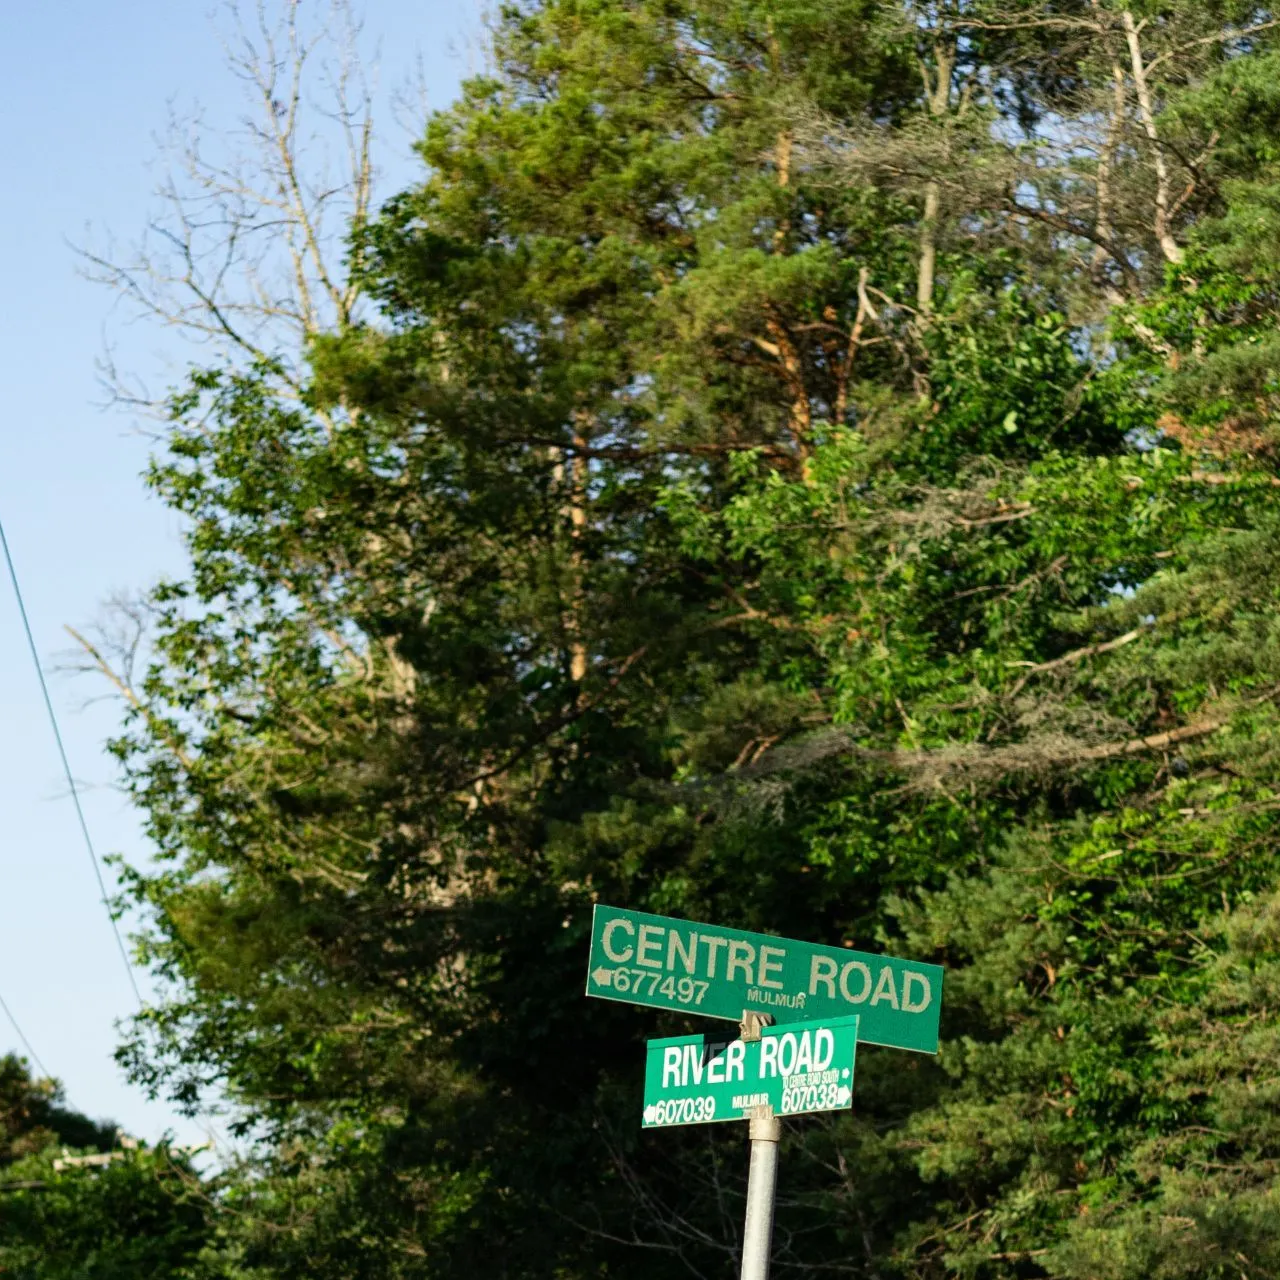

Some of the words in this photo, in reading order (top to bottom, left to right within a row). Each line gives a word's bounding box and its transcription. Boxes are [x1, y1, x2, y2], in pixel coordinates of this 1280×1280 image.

[601, 918, 787, 990] CENTRE
[808, 954, 932, 1014] ROAD
[612, 967, 710, 1006] 677497
[747, 988, 806, 1009] MULMUR
[662, 1039, 746, 1088] RIVER
[759, 1027, 835, 1079] ROAD
[654, 1096, 716, 1125] 607039
[781, 1083, 839, 1114] 607038
